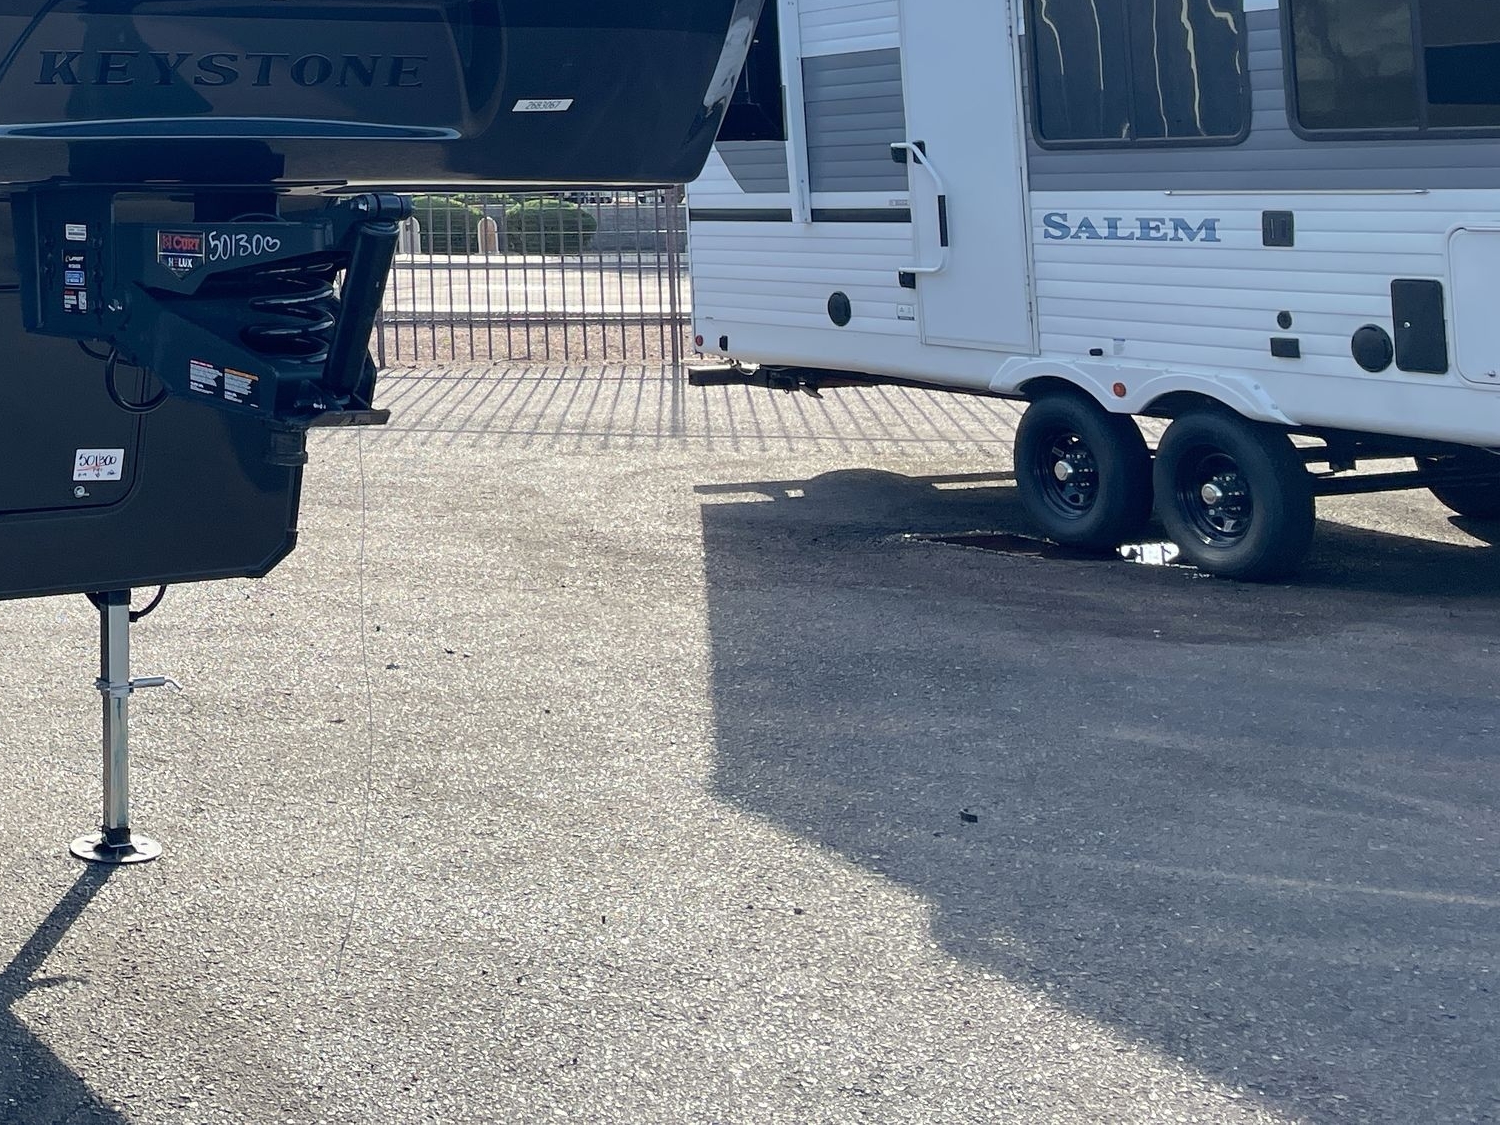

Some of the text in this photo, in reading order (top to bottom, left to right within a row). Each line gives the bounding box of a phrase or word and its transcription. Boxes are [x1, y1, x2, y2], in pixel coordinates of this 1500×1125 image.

[34, 49, 429, 88] KEYSTONE
[1042, 212, 1221, 242] SALEM
[173, 235, 200, 251] CURT
